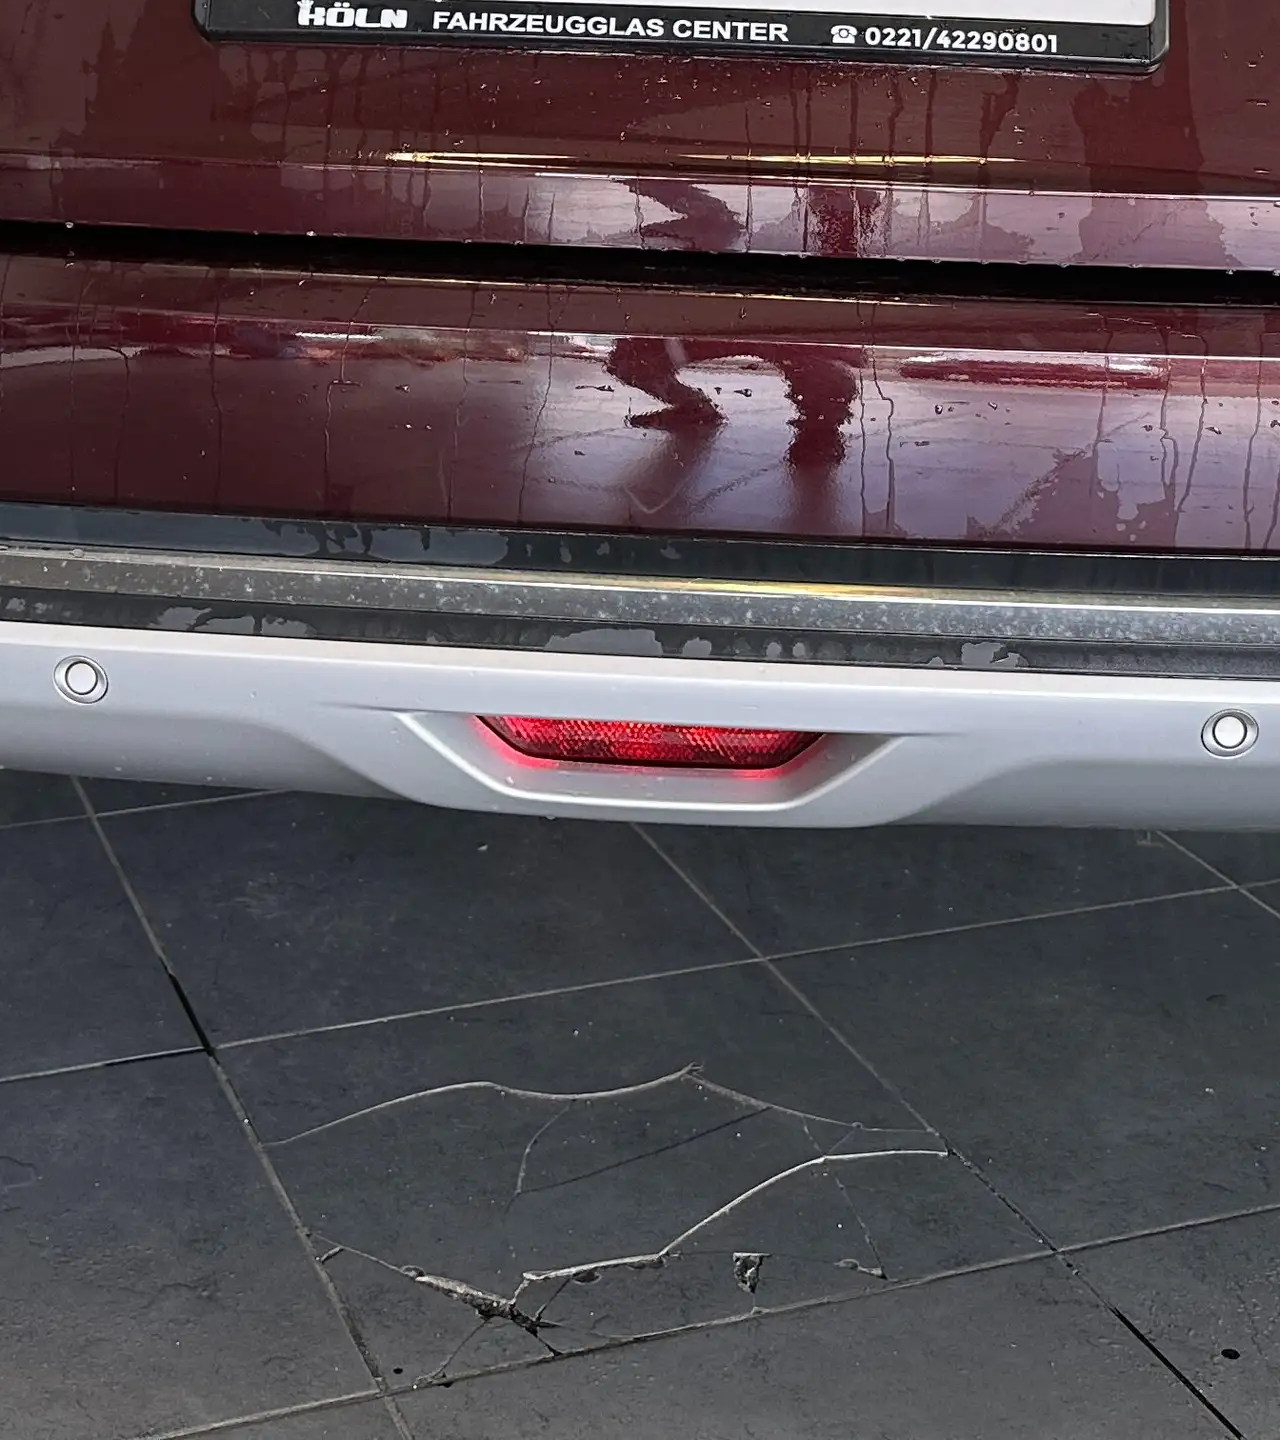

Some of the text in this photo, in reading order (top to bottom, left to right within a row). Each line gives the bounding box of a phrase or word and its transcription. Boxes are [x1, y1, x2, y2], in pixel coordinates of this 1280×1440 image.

[297, 0, 1058, 53] KÖLN FAHRZEUGGLAS CENTER 0221/42290801
